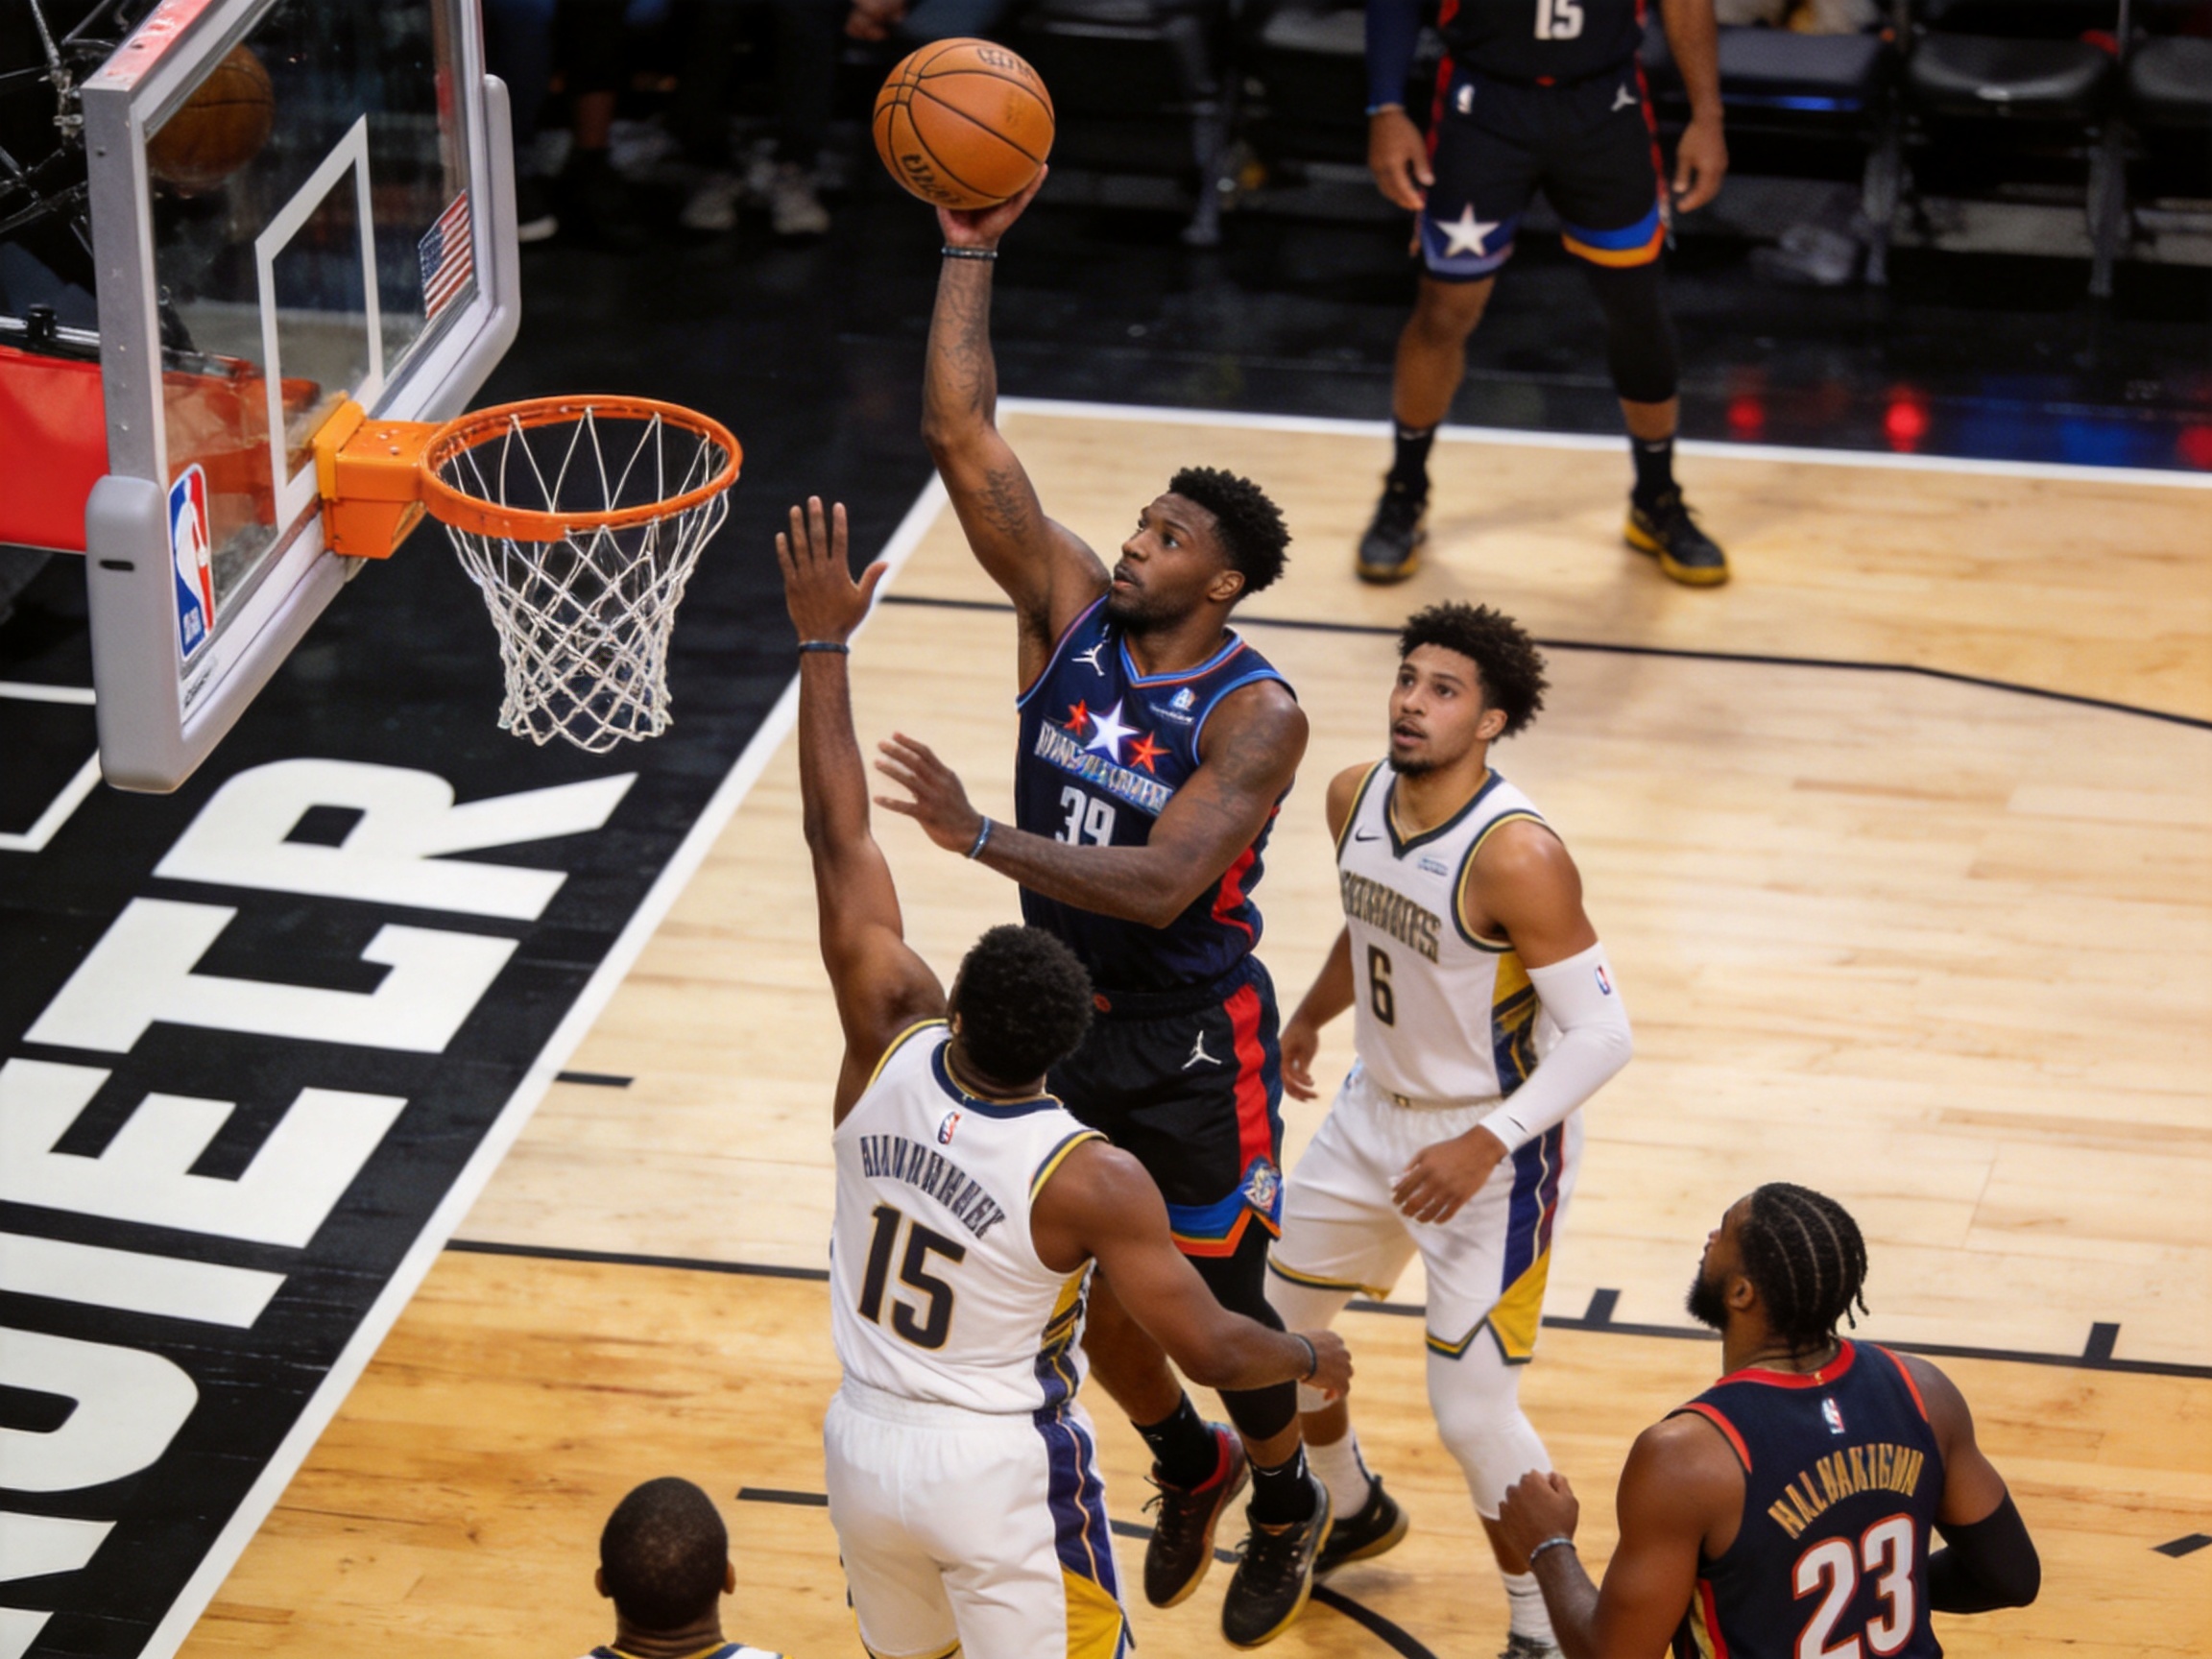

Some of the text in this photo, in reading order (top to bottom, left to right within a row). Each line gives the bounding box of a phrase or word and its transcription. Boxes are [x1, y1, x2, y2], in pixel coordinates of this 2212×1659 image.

[1534, 0, 1584, 40] 15
[1055, 785, 1116, 847] 39
[1367, 943, 1396, 1027] 6
[857, 1199, 967, 1353] 15
[1791, 1512, 1916, 1659] 23
